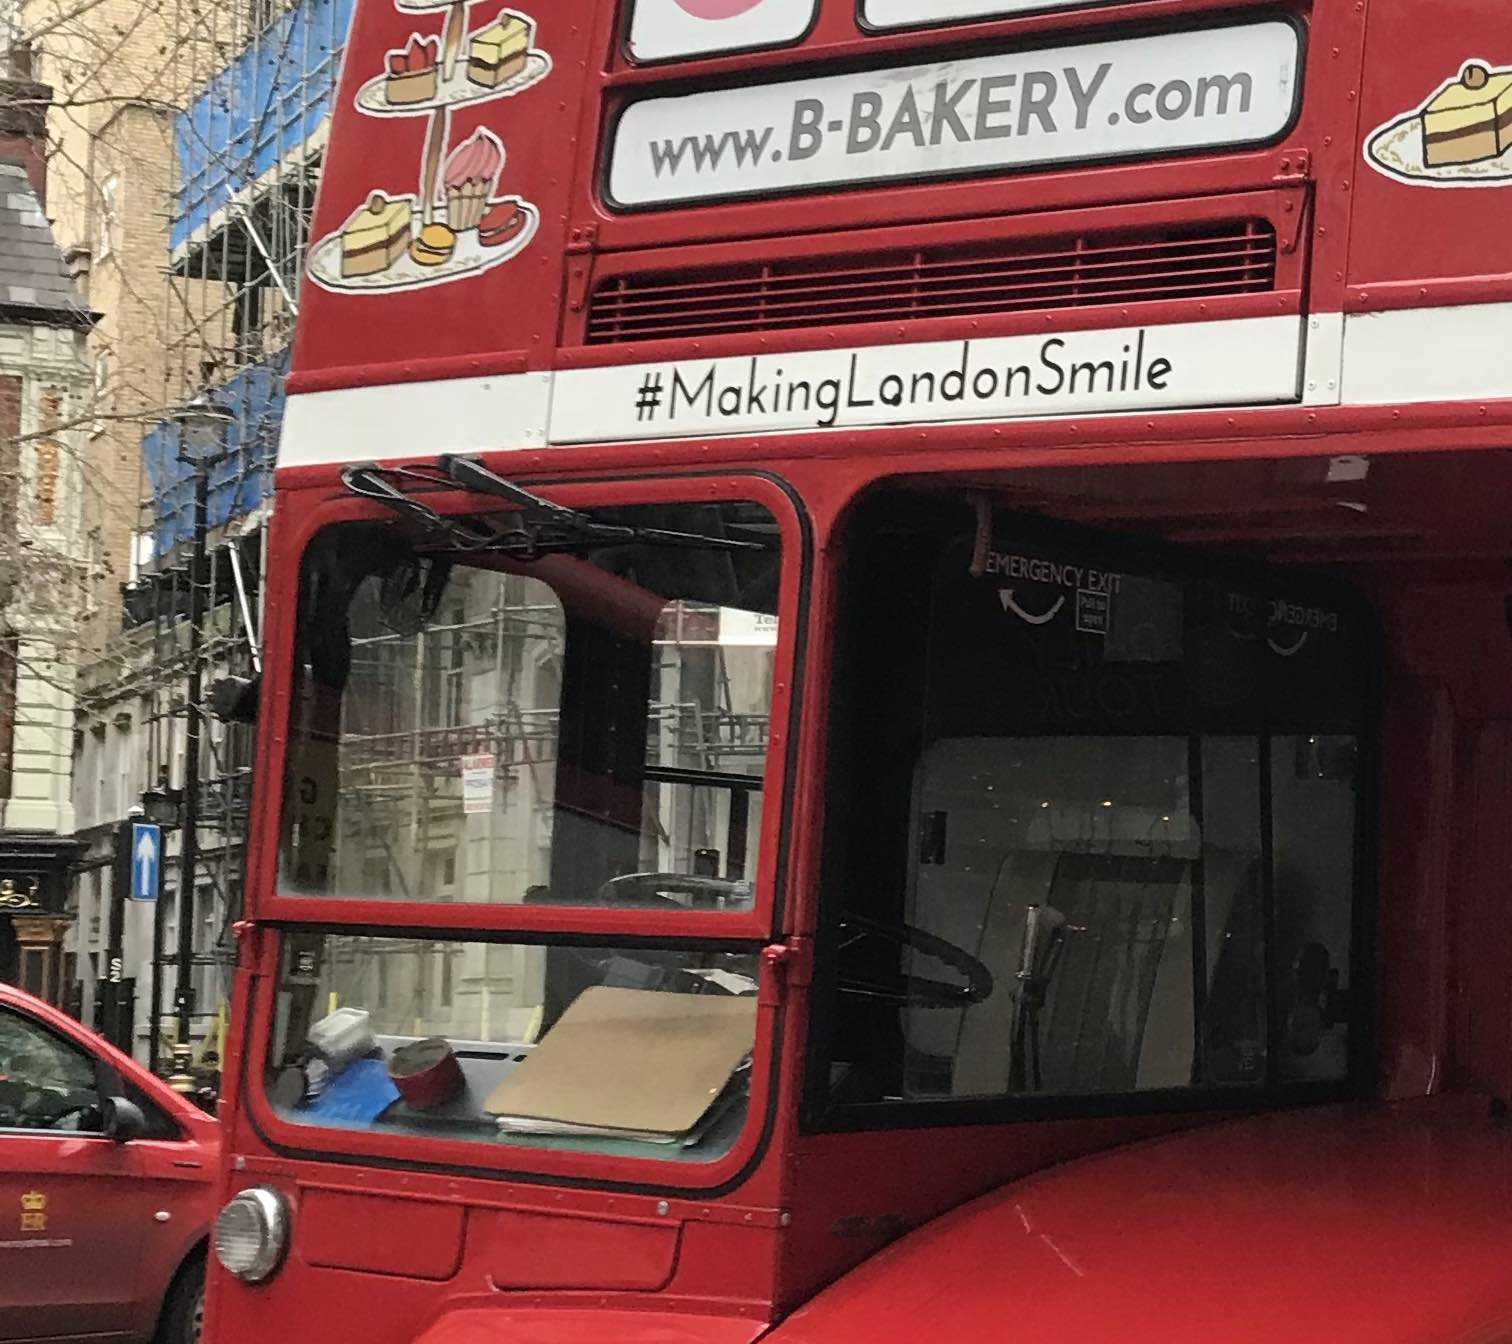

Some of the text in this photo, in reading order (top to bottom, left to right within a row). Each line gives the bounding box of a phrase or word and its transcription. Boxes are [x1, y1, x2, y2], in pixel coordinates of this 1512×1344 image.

[648, 63, 1253, 180] www.B-BAKERY.com
[635, 329, 1174, 428] #MakingLondonSmile
[985, 551, 1122, 594] EMERGENCY EXIT
